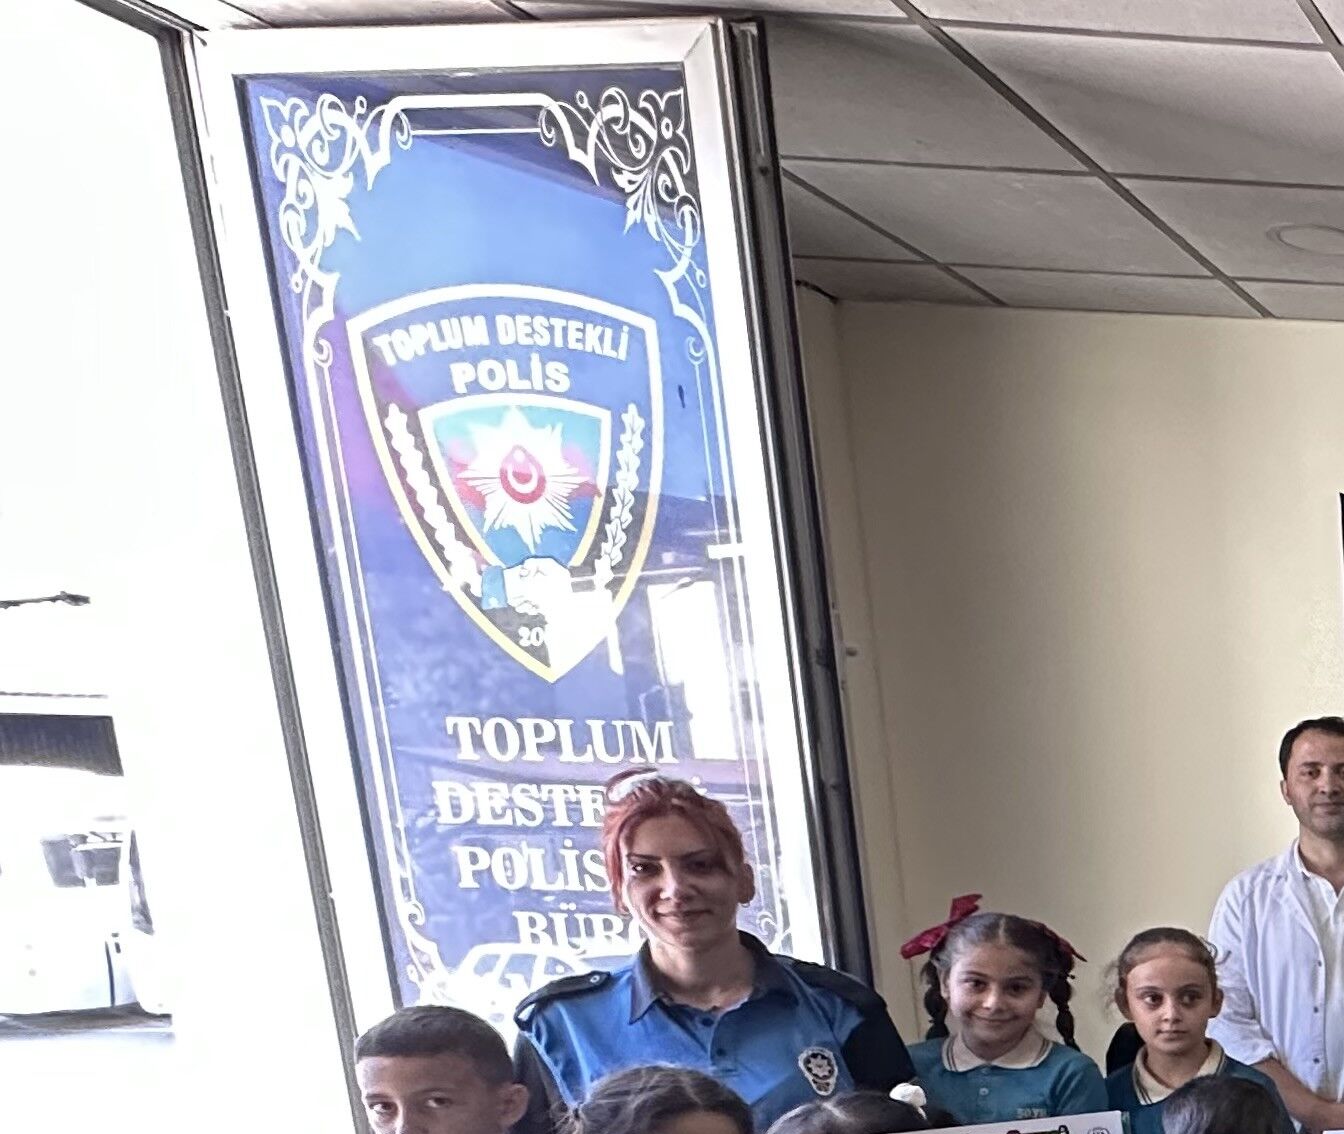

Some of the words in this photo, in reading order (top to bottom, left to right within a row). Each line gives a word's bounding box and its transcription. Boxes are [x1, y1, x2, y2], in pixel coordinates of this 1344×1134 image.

[372, 314, 490, 367] TOPLUM
[495, 314, 630, 362] DESTEKLİ
[449, 353, 571, 394] POLİS
[445, 716, 680, 764] TOPLUM
[431, 780, 607, 828] DESTE
[452, 838, 613, 892] POLİS
